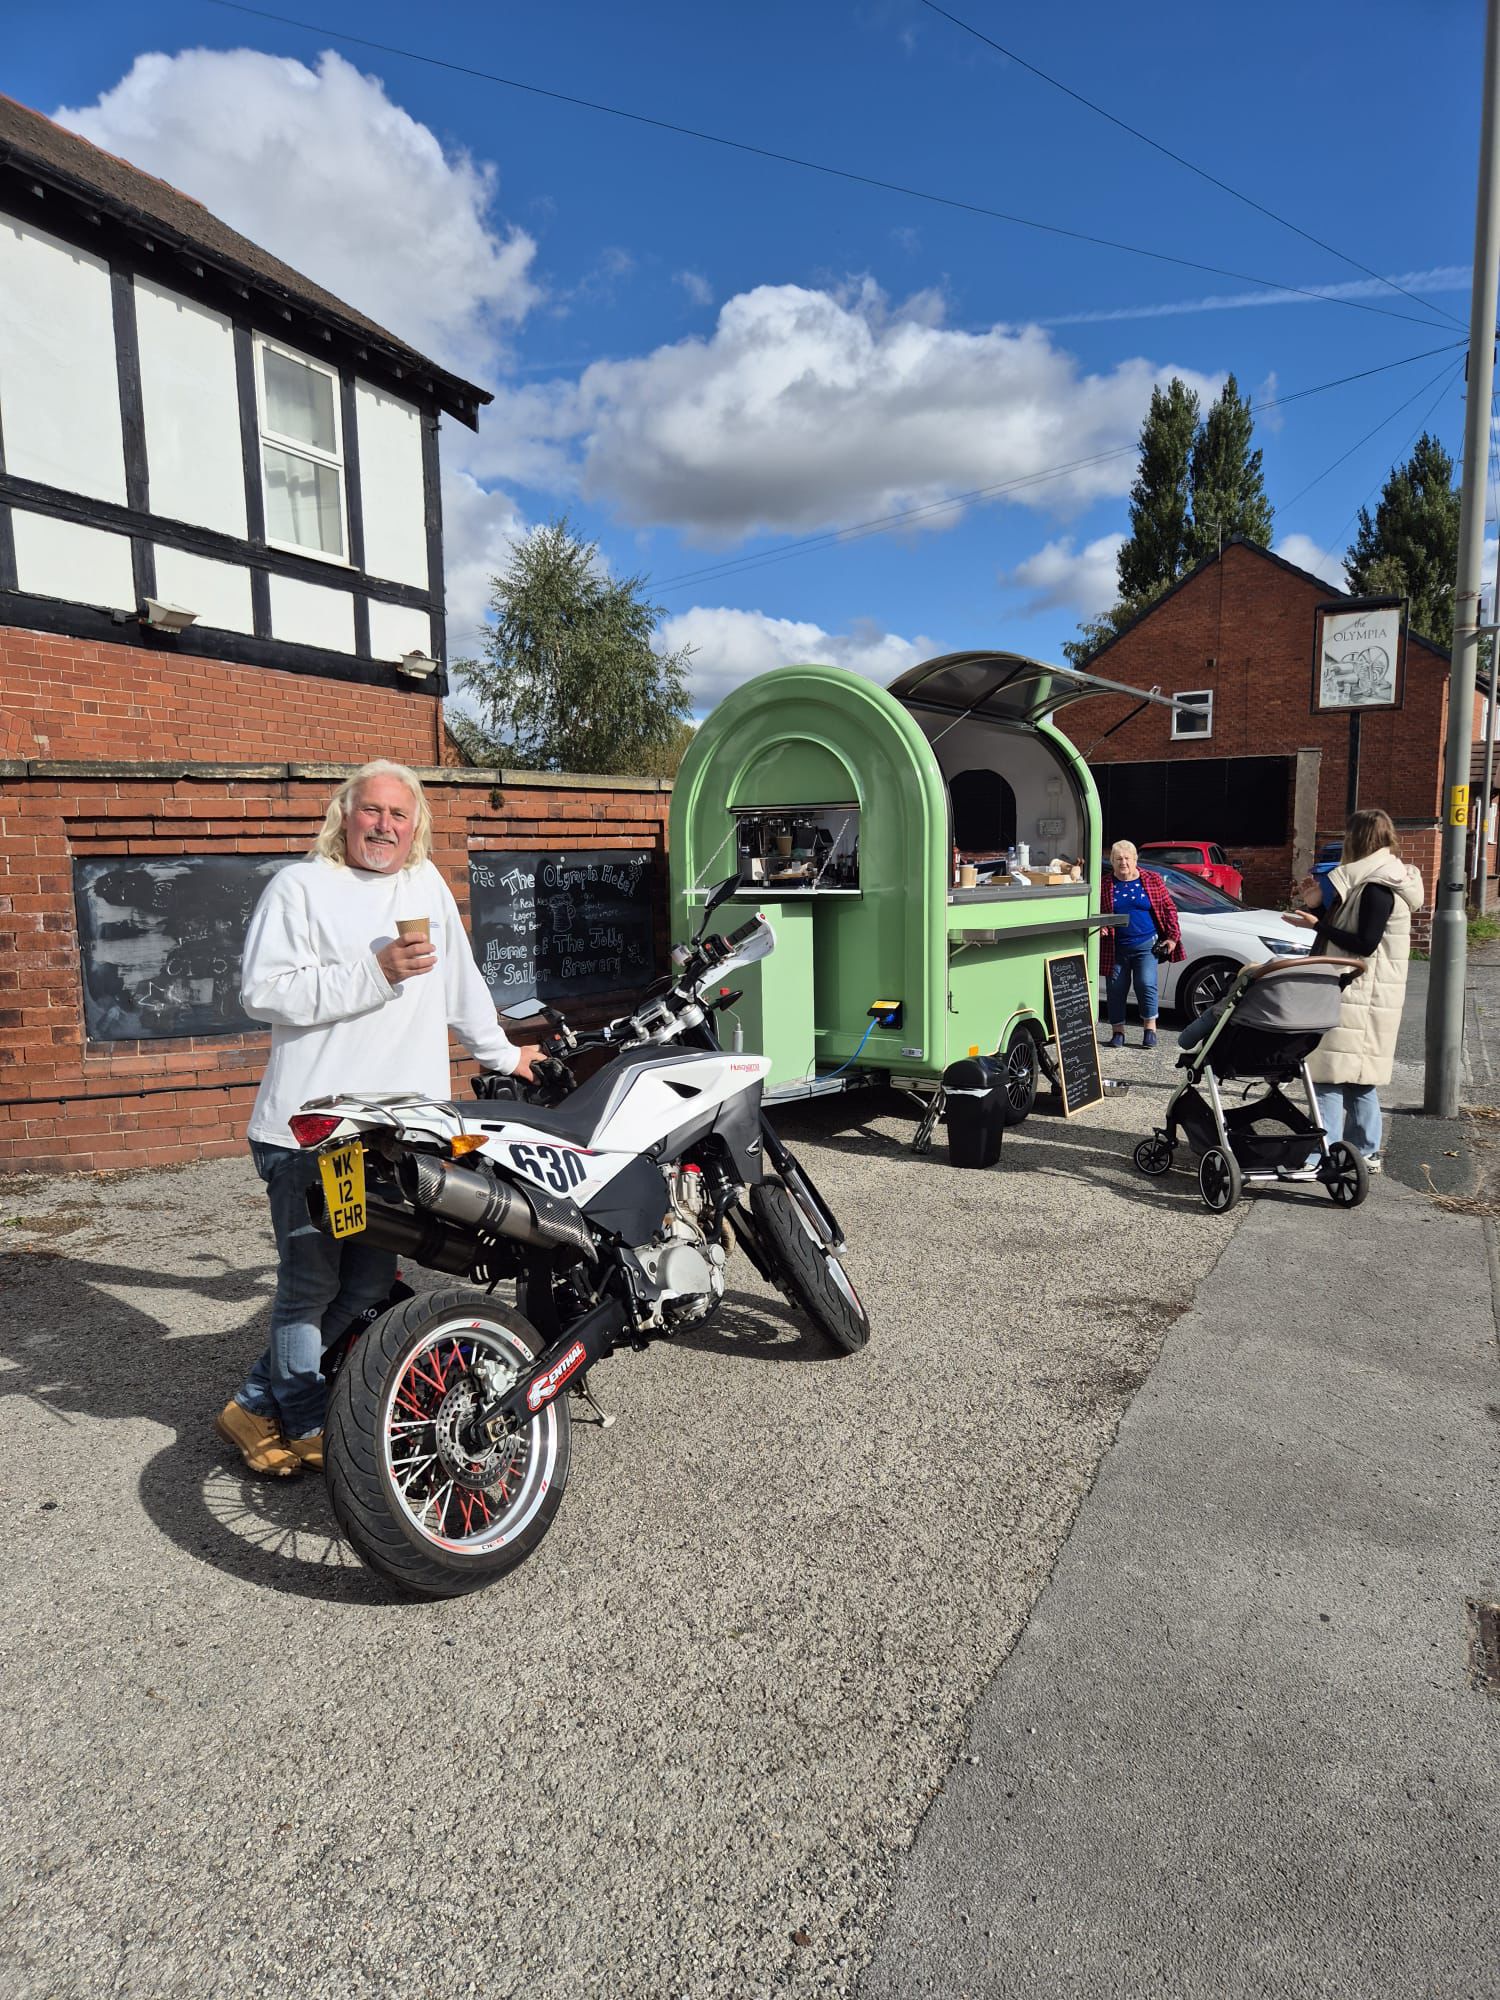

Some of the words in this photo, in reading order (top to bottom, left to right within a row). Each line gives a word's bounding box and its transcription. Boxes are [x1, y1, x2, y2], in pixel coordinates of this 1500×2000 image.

[1333, 629, 1388, 642] OLYMPIA
[1354, 619, 1366, 628] the
[500, 868, 536, 896] The
[543, 864, 599, 891] Olympia
[520, 898, 535, 909] Real
[513, 910, 537, 923] Lagers
[513, 923, 527, 935] Key
[486, 939, 528, 961] Home
[552, 933, 585, 953] The
[589, 927, 624, 954] Jolly
[503, 961, 552, 986] Sailor
[561, 956, 621, 978] Brewery
[332, 1151, 354, 1179] WK
[338, 1180, 354, 1205] 12
[333, 1203, 364, 1234] EHR
